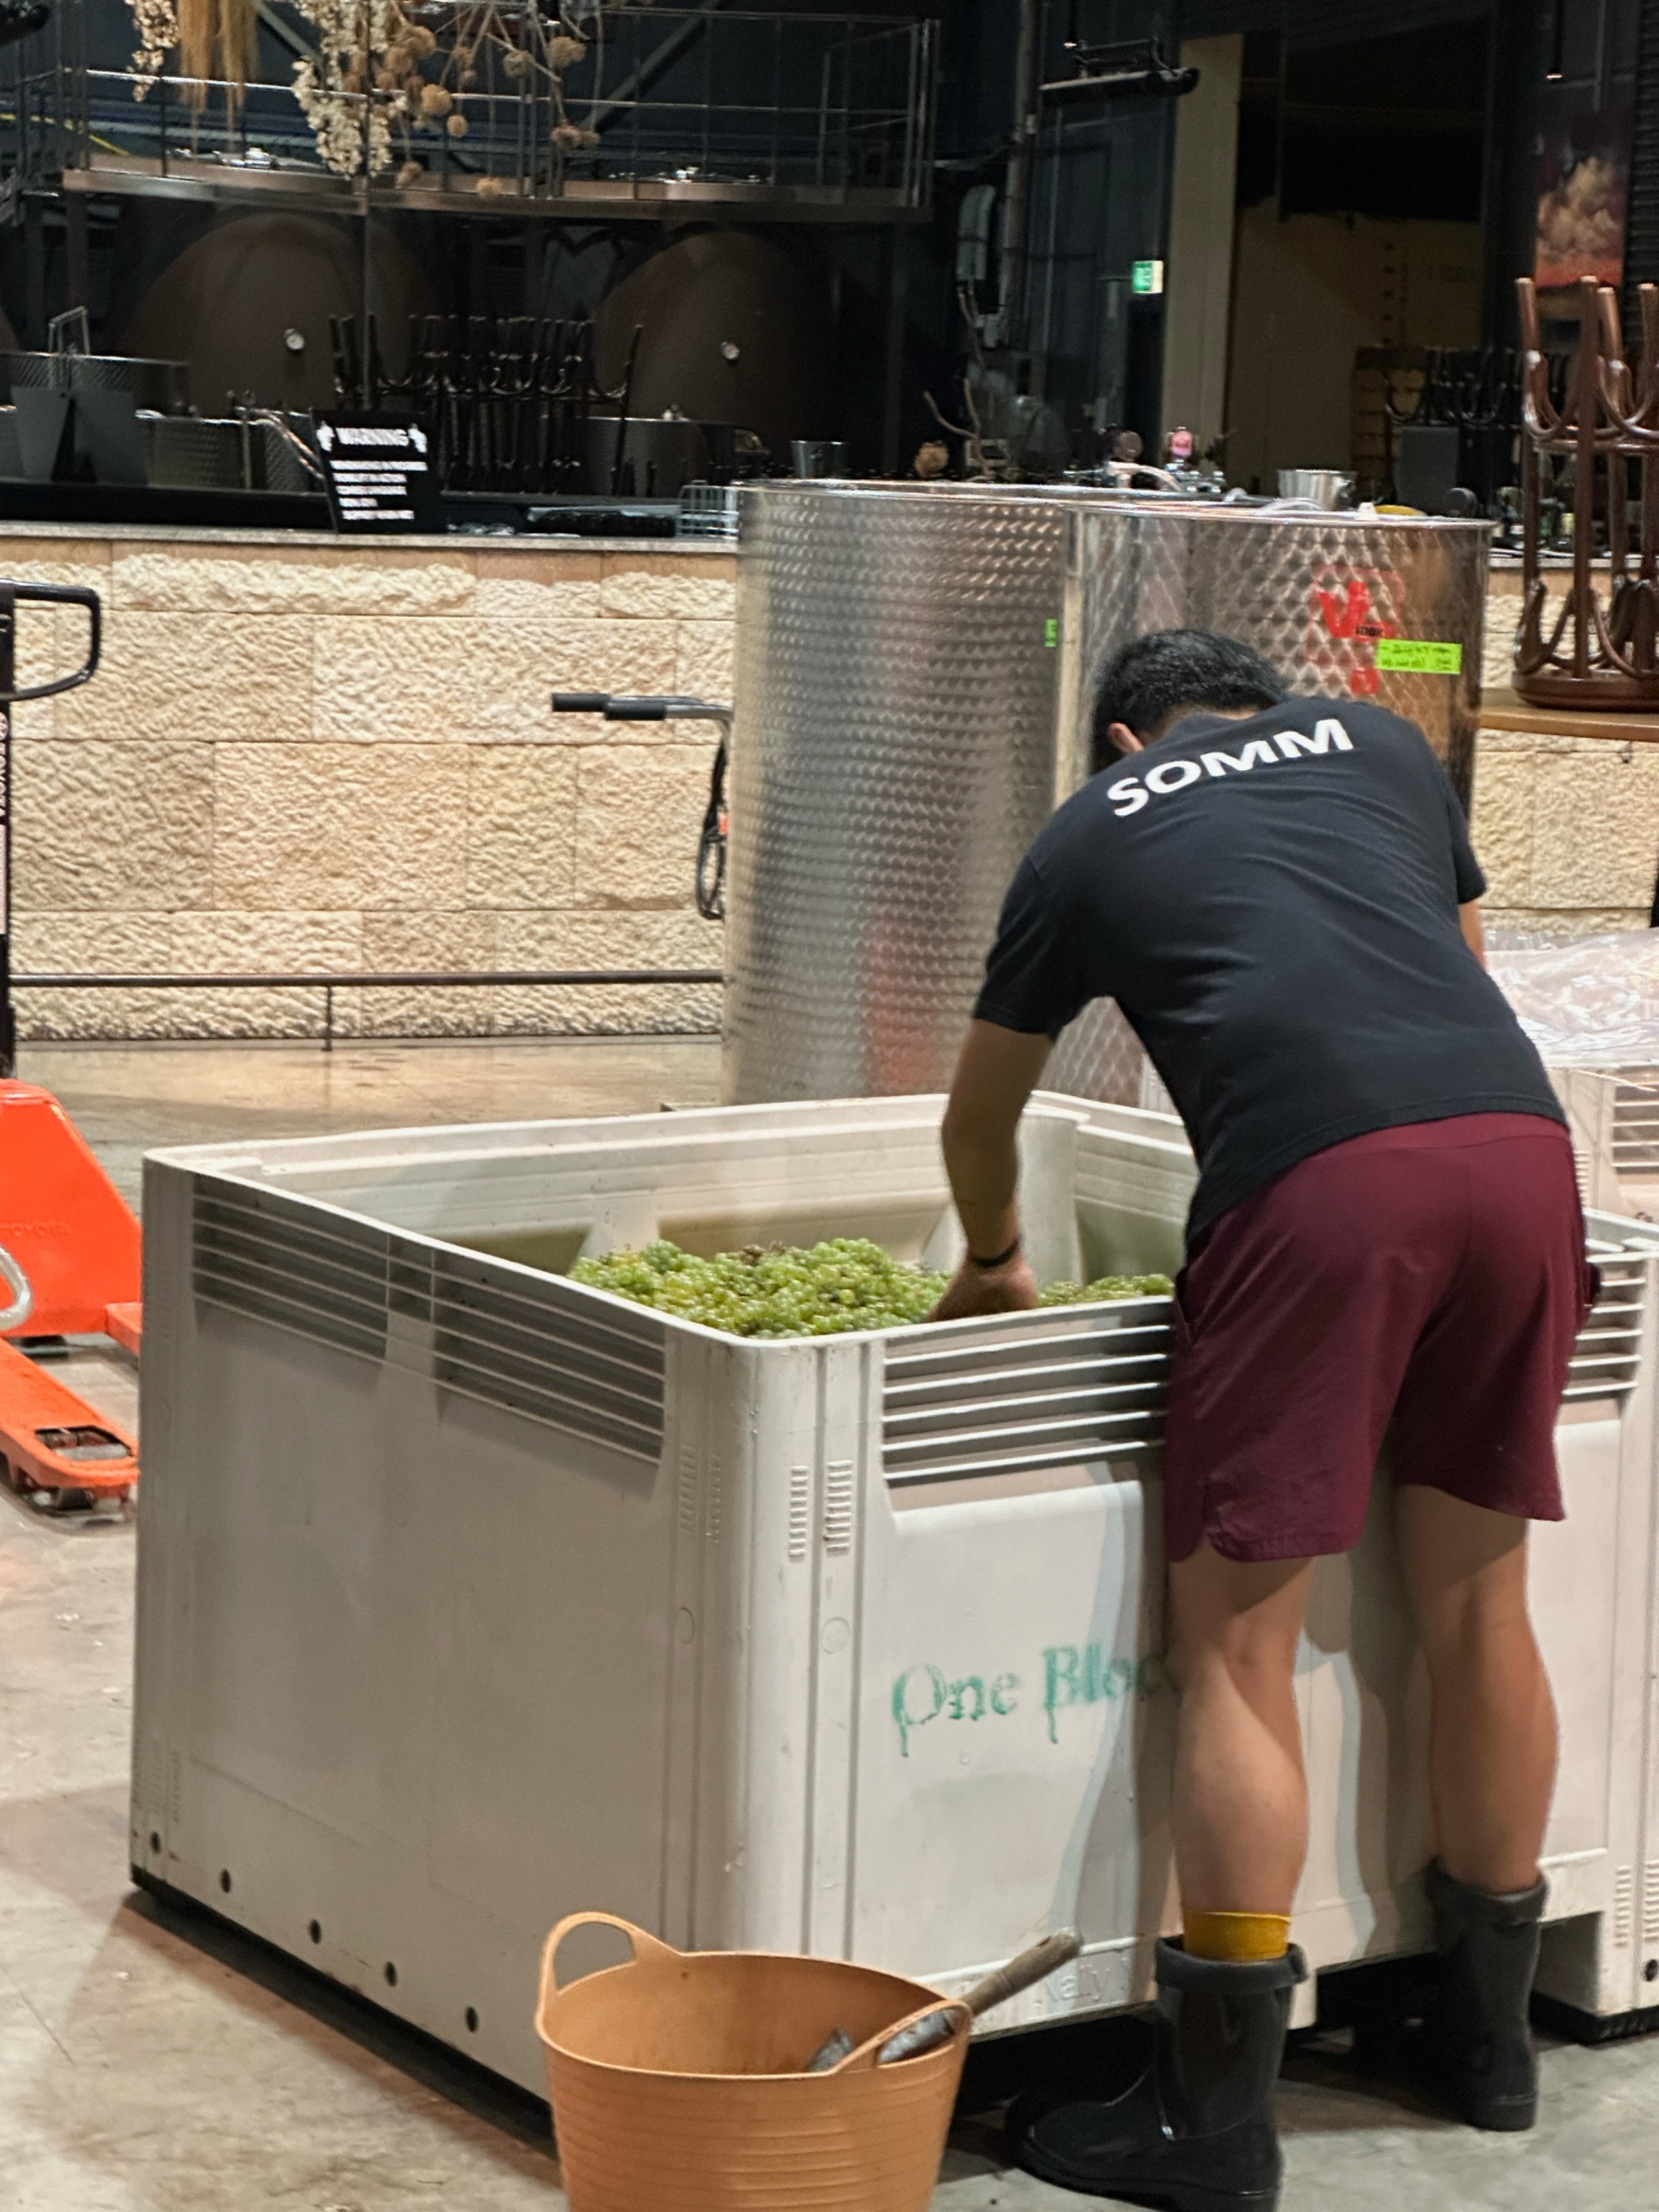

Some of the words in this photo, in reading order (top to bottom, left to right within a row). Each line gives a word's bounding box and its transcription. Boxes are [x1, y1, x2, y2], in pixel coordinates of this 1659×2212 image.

[1107, 718, 1354, 816] SOMM
[891, 1662, 1020, 1752] One
[1042, 1642, 1174, 1742] Bloc
